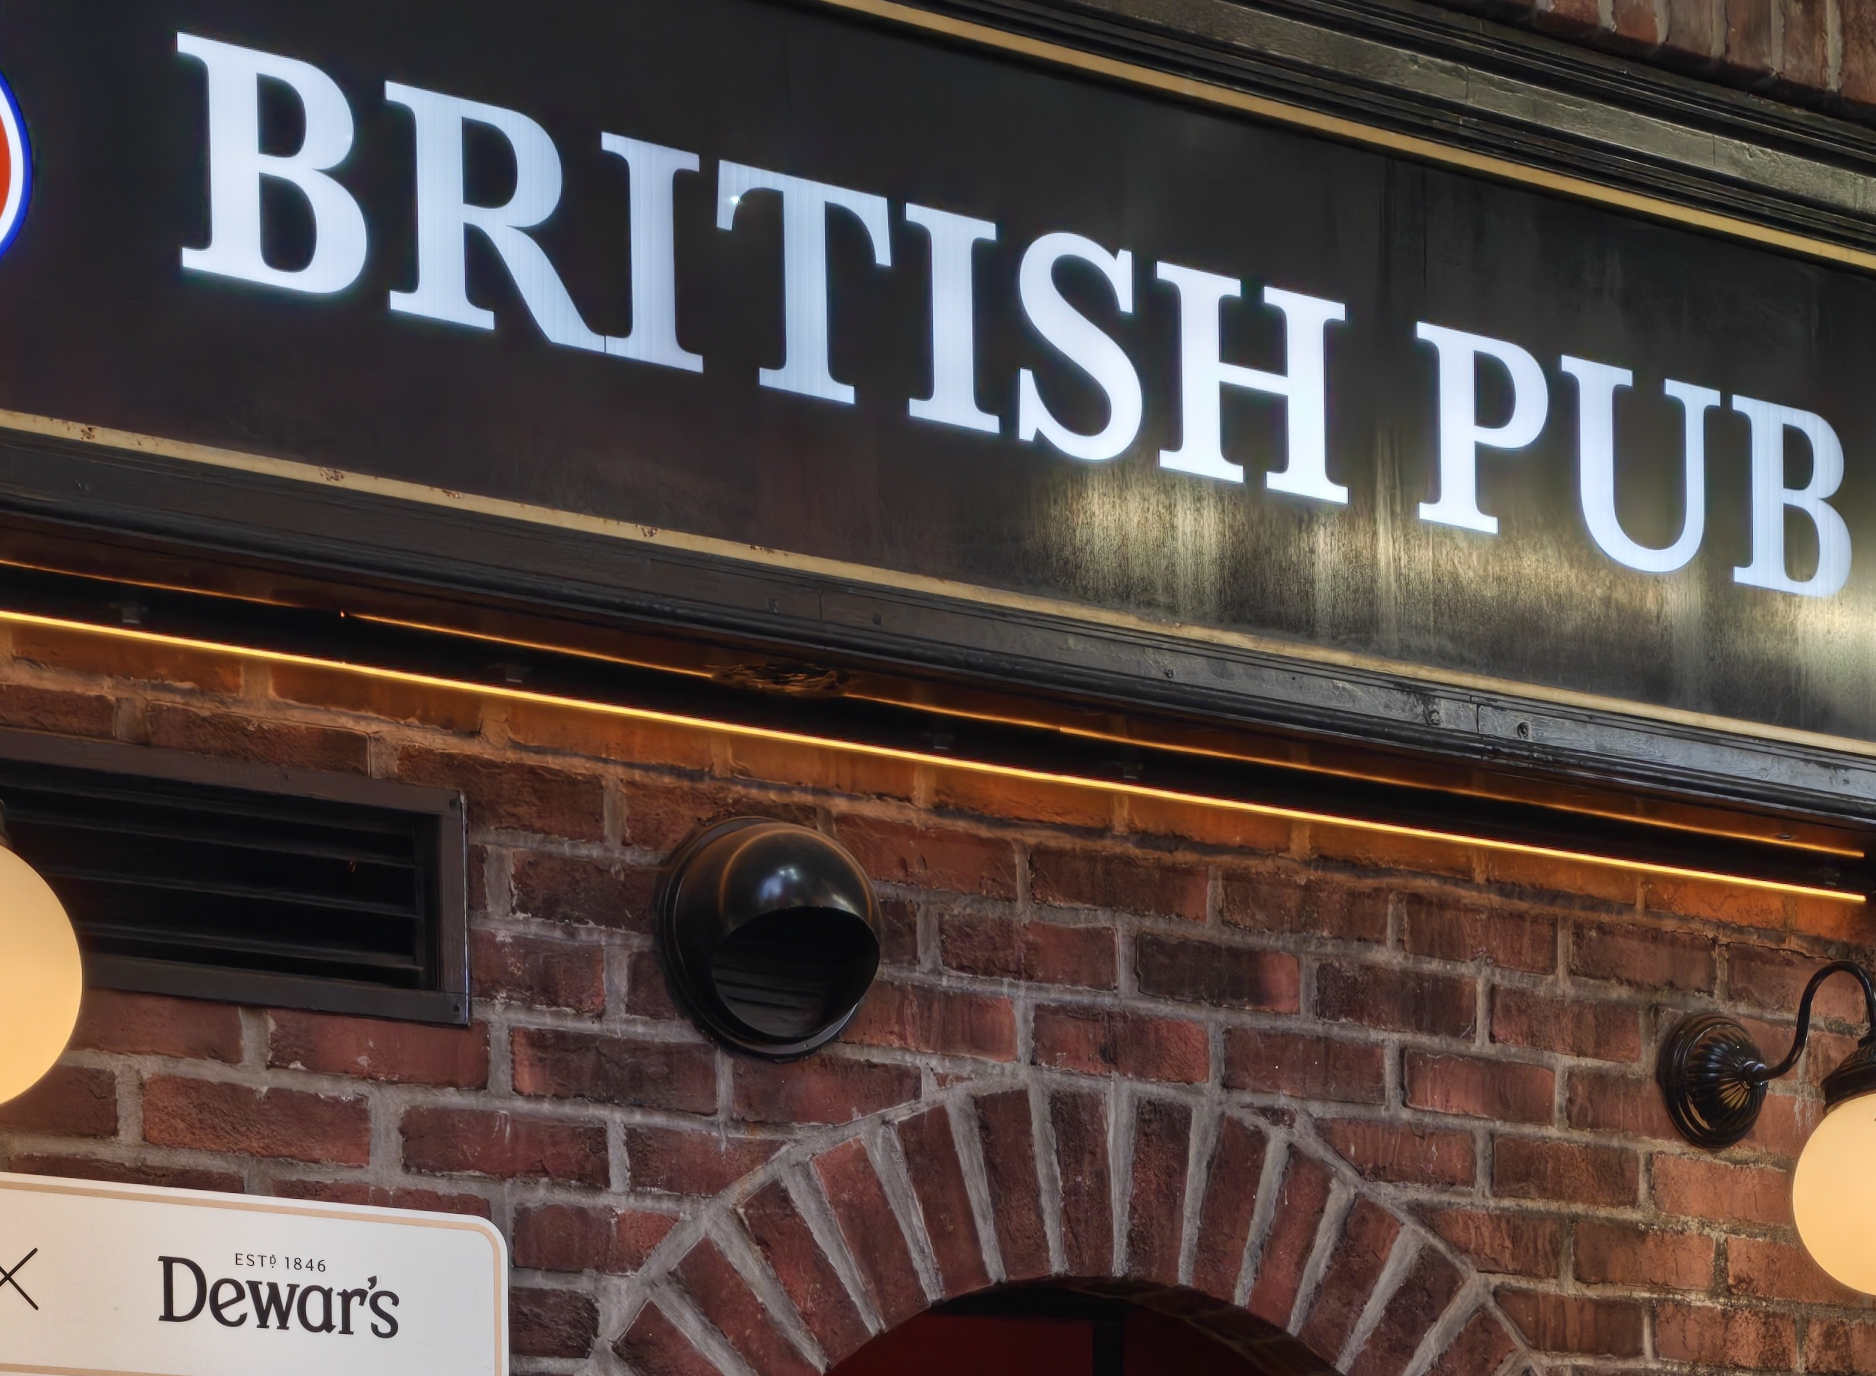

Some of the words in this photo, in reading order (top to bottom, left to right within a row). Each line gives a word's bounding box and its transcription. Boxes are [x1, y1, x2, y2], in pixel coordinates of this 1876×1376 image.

[176, 31, 1348, 504] BRITISH
[1416, 320, 1853, 598] PUB
[158, 1256, 400, 1338] Dewar's
[284, 1256, 326, 1272] 1846
